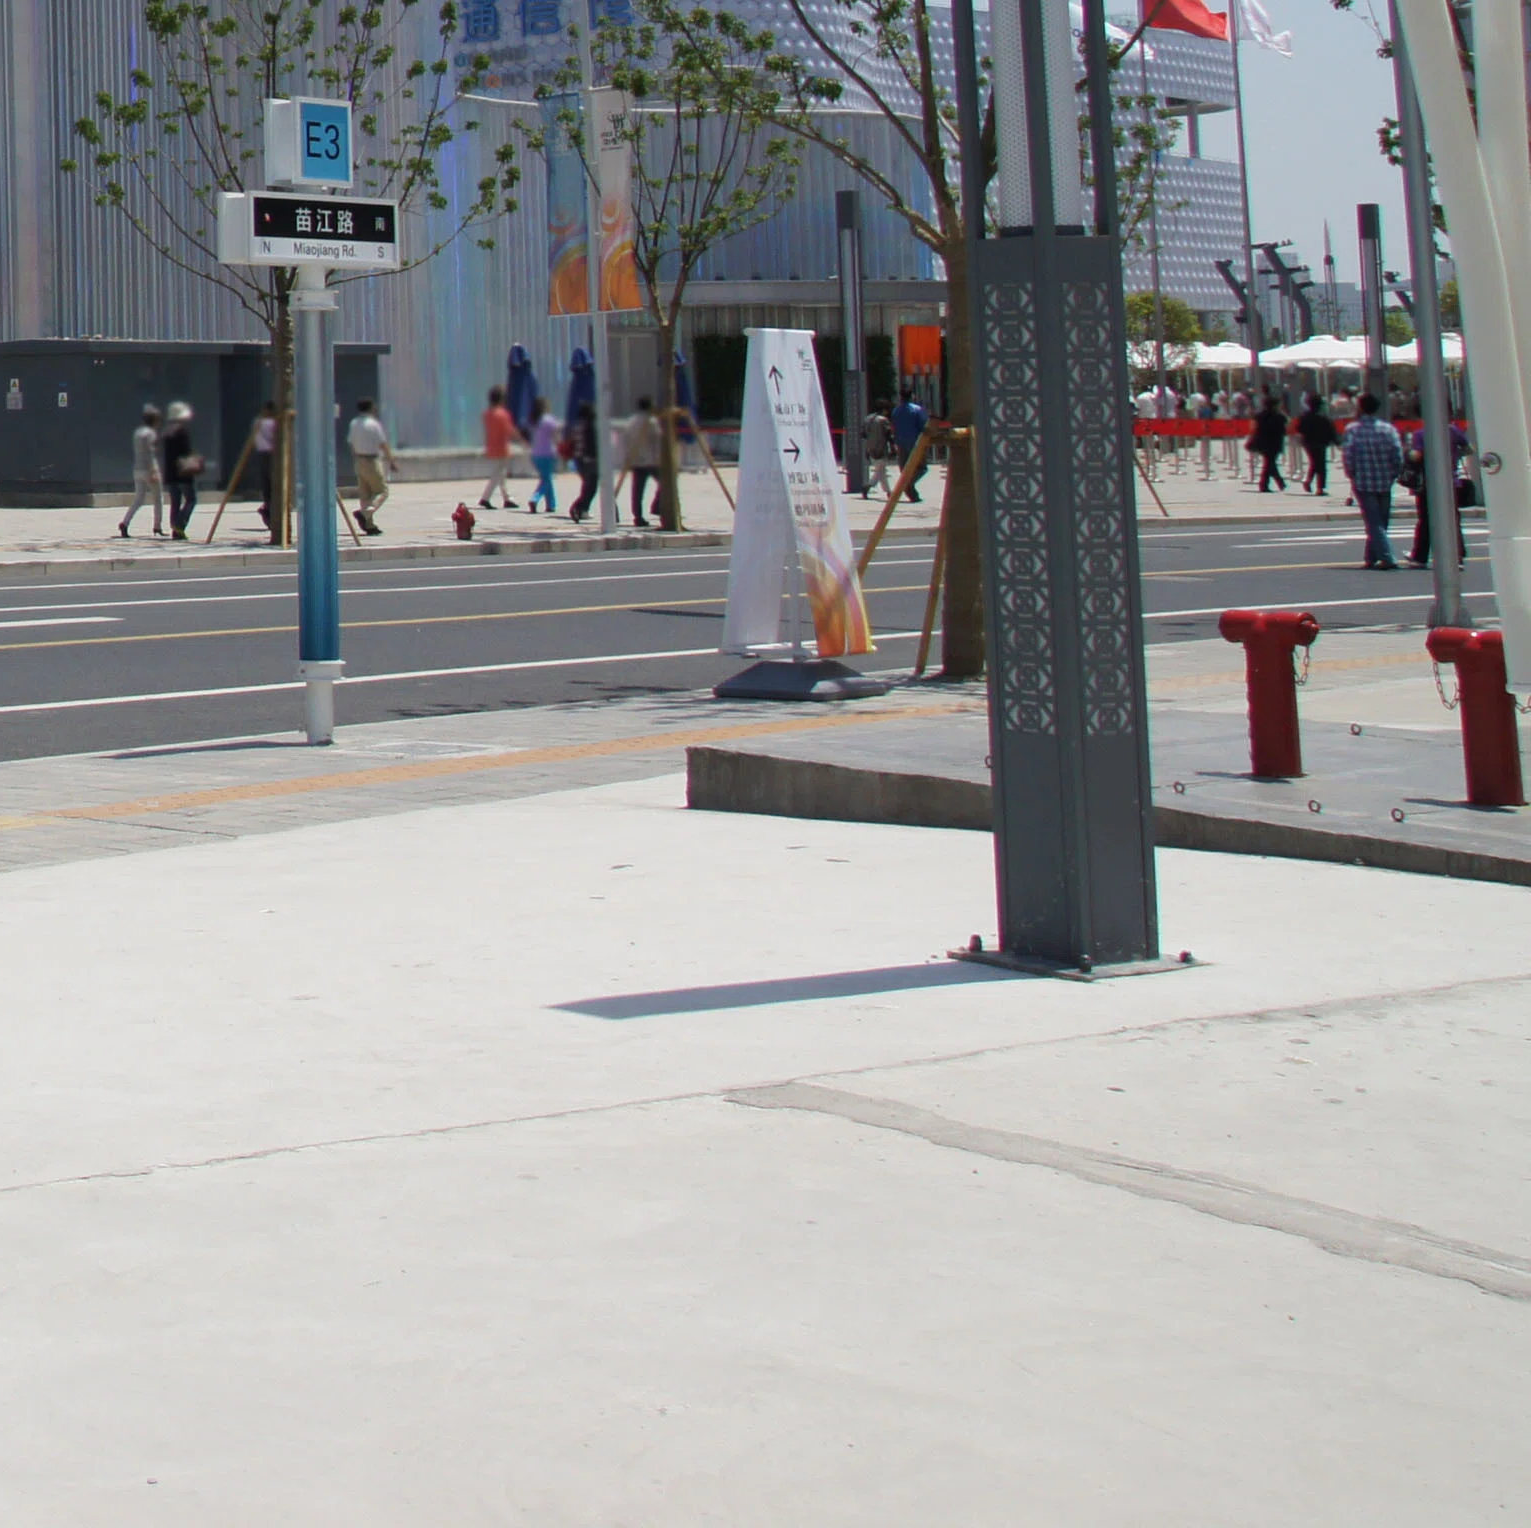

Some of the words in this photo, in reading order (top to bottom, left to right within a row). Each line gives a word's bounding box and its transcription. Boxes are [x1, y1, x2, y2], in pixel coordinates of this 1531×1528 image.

[305, 121, 340, 160] E3
[295, 207, 354, 235] 苗江路
[262, 241, 271, 253] N
[293, 242, 340, 259] Miaojiang
[377, 246, 385, 258] S
